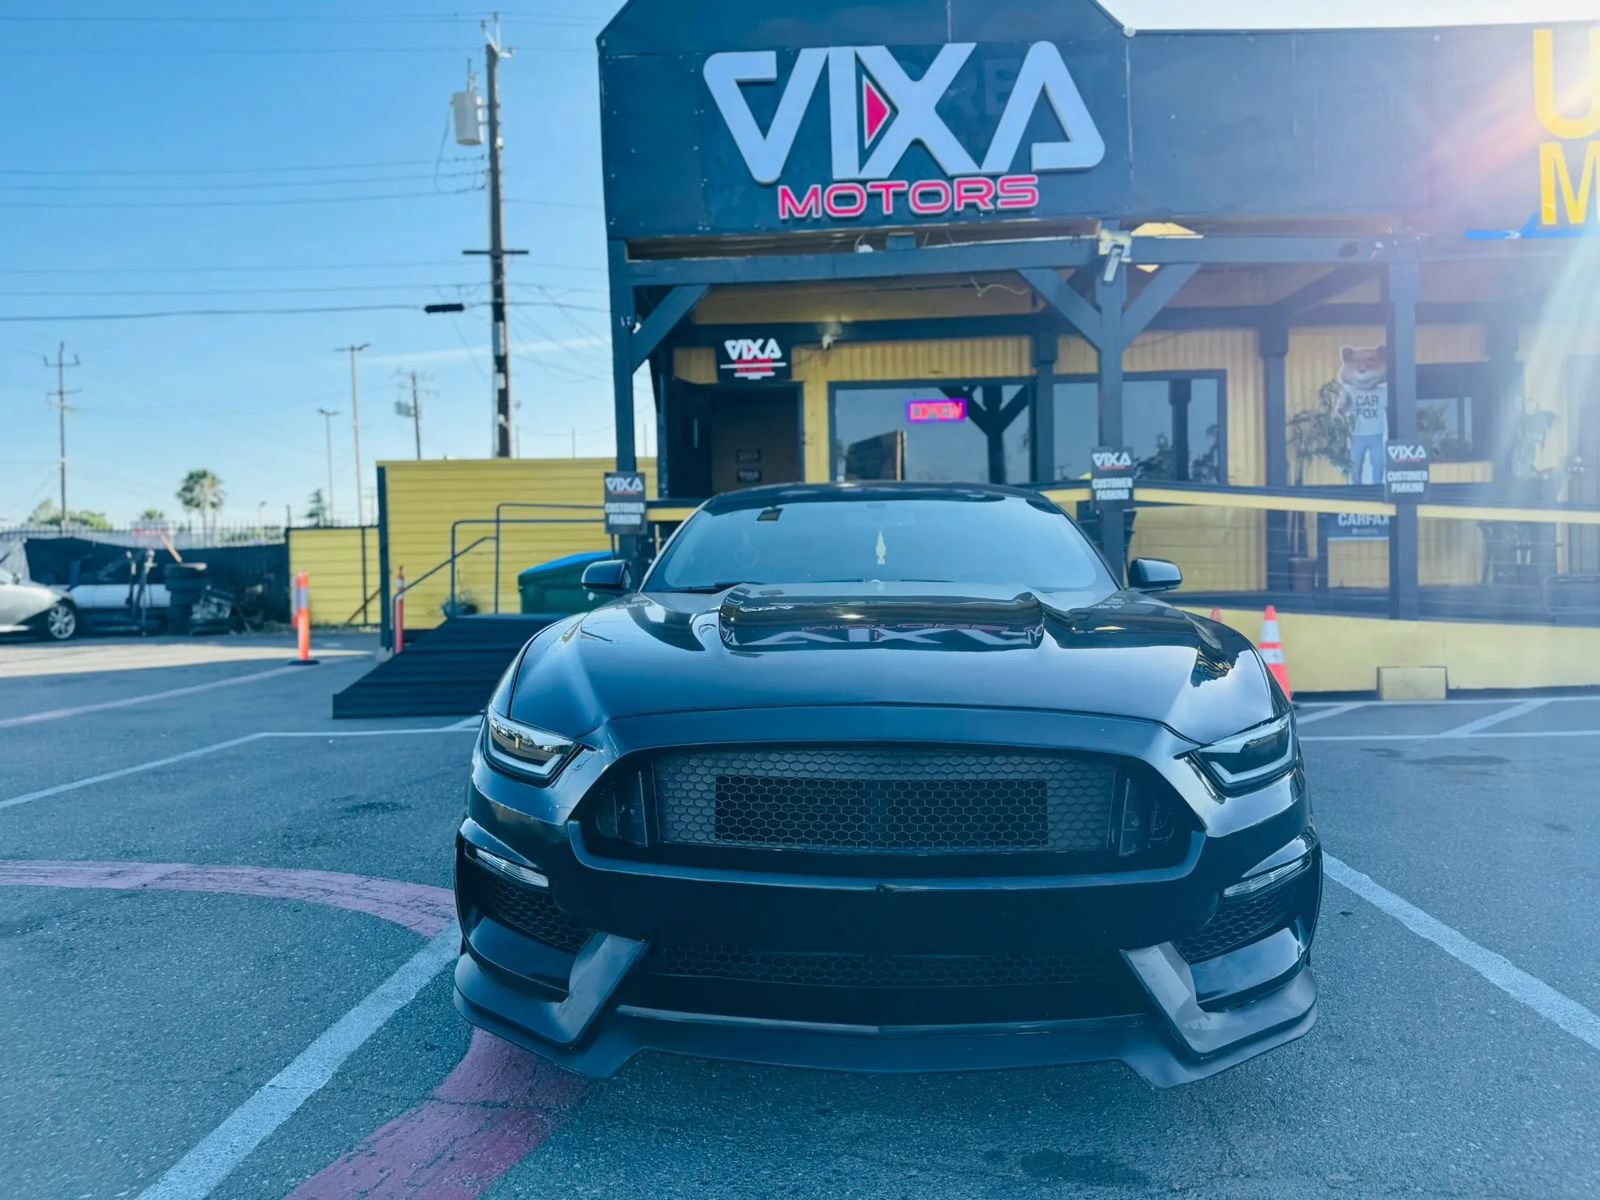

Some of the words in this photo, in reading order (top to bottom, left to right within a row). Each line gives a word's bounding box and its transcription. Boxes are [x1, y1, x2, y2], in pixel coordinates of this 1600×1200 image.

[703, 40, 1105, 184] VIXA
[777, 175, 1040, 220] MOTORS
[724, 338, 782, 361] VIXA
[1355, 394, 1380, 406] CAR
[910, 402, 963, 420] OPEN
[1356, 407, 1380, 420] FOX
[1092, 451, 1132, 467] VIXA
[1387, 444, 1427, 459] VIXA
[605, 477, 644, 491] VIXA
